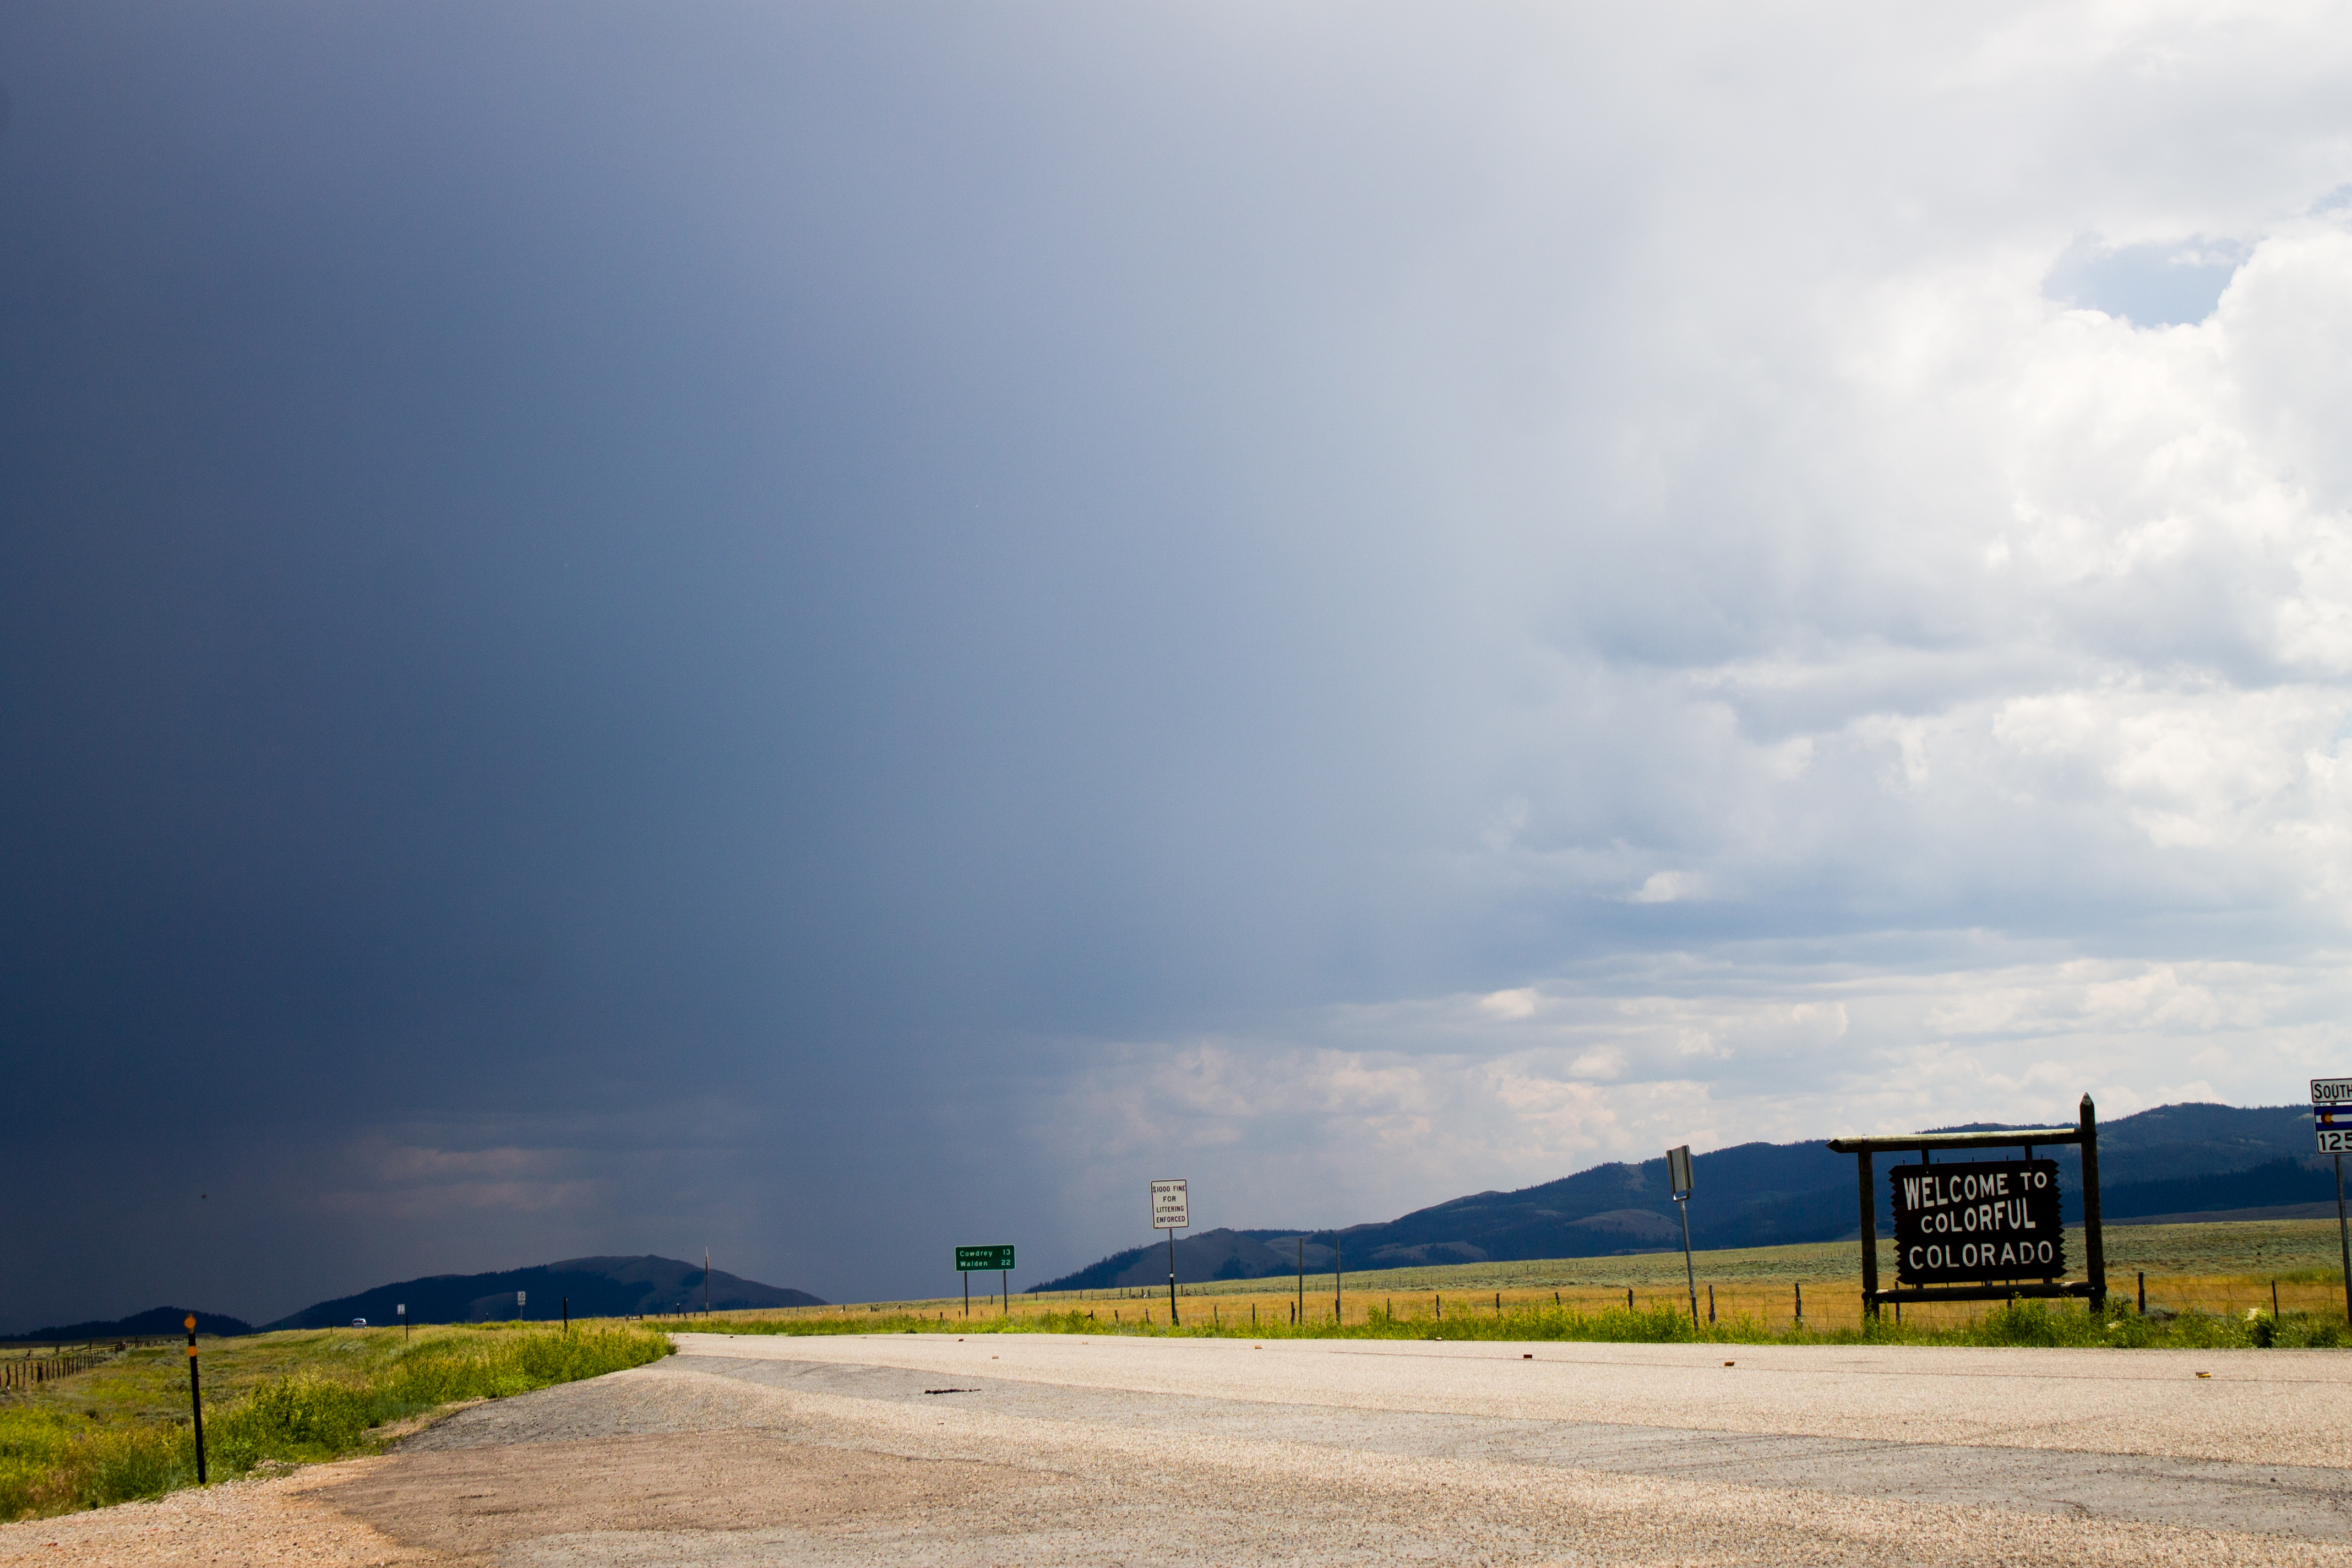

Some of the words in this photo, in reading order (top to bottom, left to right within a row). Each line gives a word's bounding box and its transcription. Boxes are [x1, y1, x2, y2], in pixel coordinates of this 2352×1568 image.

[2314, 1083, 2352, 1099] SOUTH
[2320, 1133, 2352, 1151] 125
[1903, 1173, 2009, 1211] WELCOME
[2020, 1172, 2047, 1190] TO
[1921, 1197, 2036, 1233] COLORFUL
[1909, 1240, 2053, 1270] COLORADO
